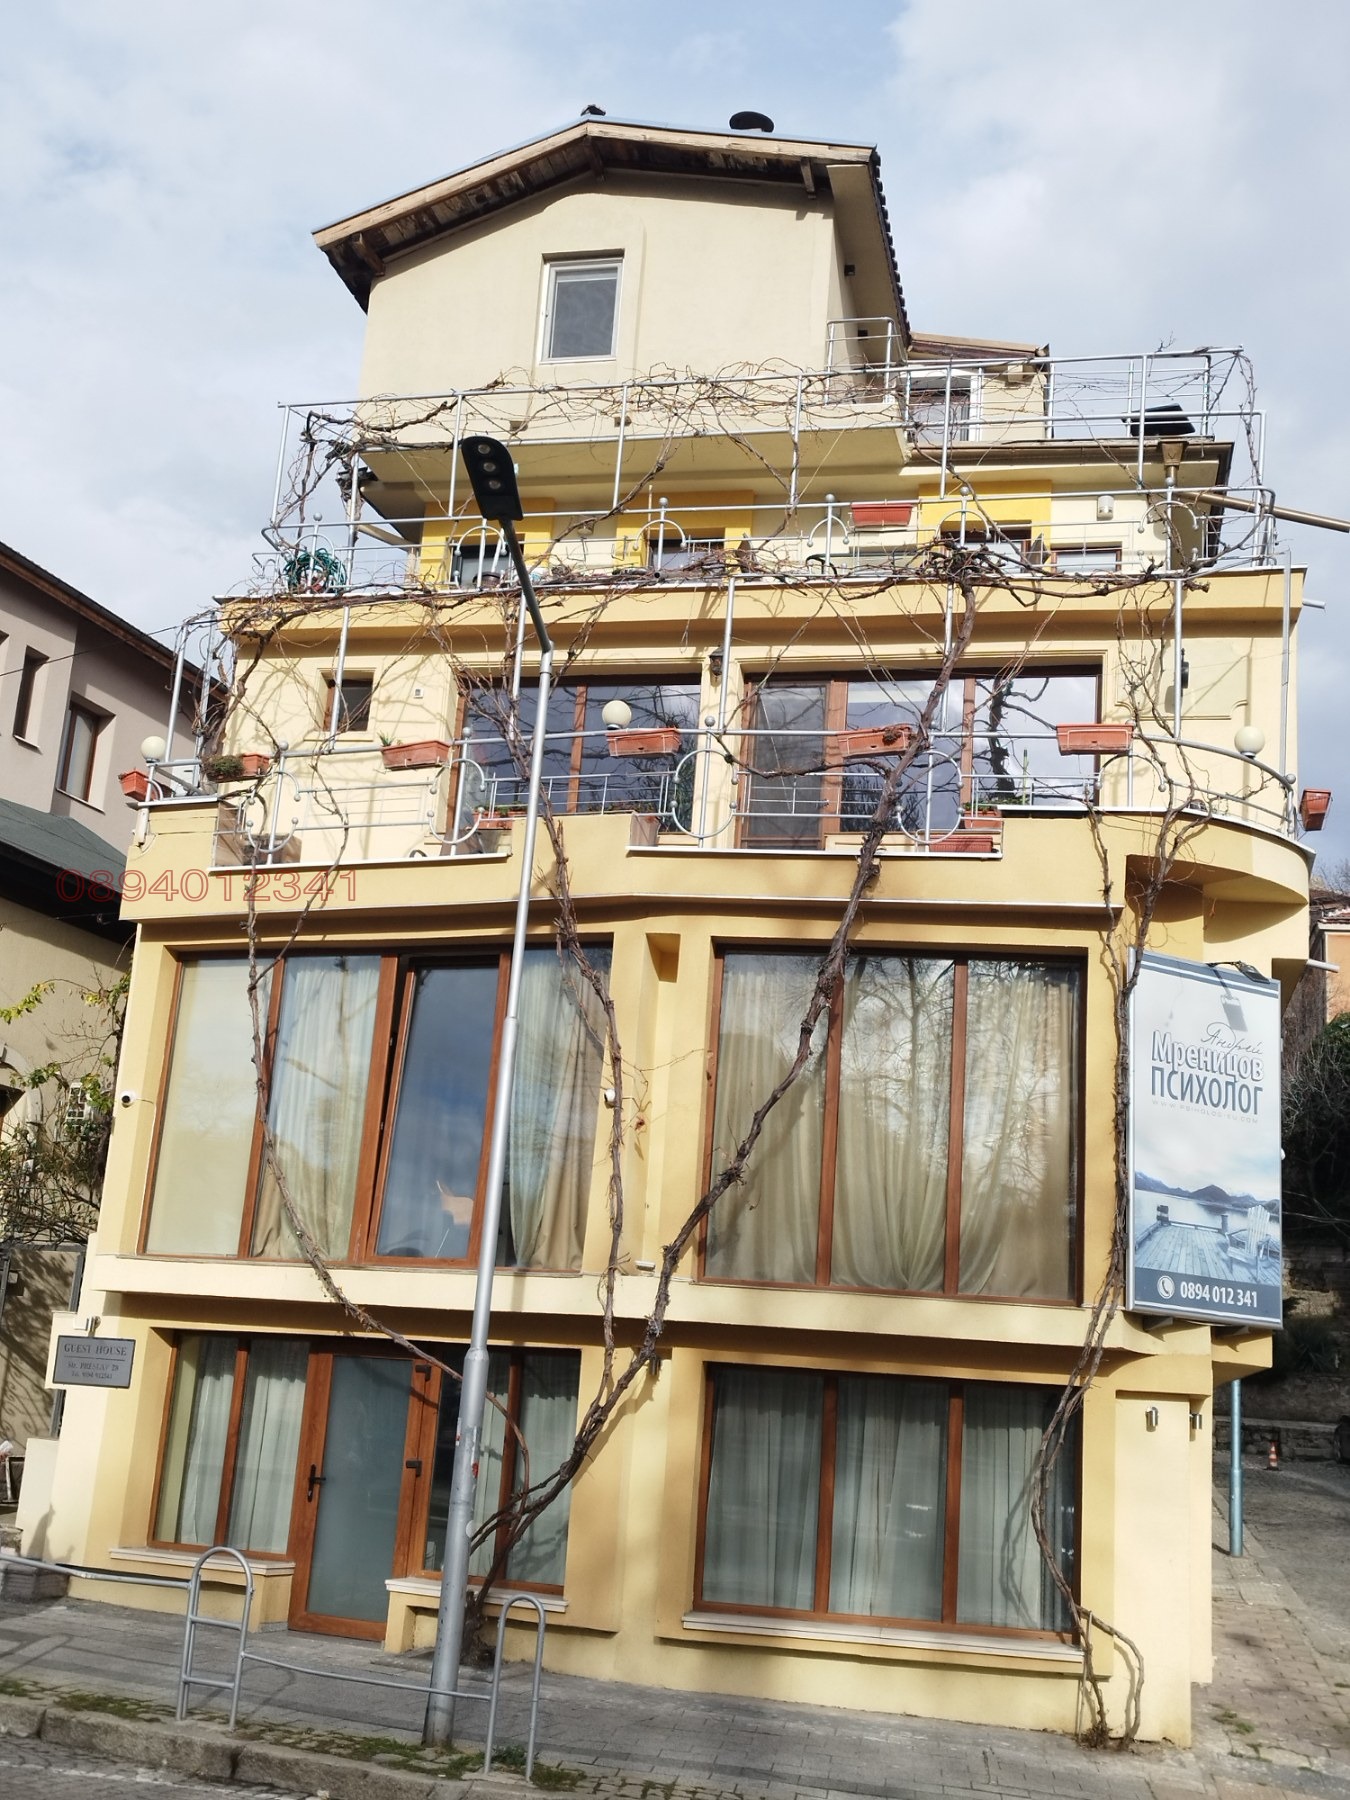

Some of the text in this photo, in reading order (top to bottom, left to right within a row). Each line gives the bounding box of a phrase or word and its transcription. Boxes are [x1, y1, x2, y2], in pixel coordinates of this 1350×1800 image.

[1152, 1030, 1264, 1082] Мреницов
[1152, 1066, 1263, 1115] ПСИХОЛОГ
[1180, 1281, 1258, 1308] 0894 012 341
[64, 1343, 127, 1356] GUEST HOUSE
